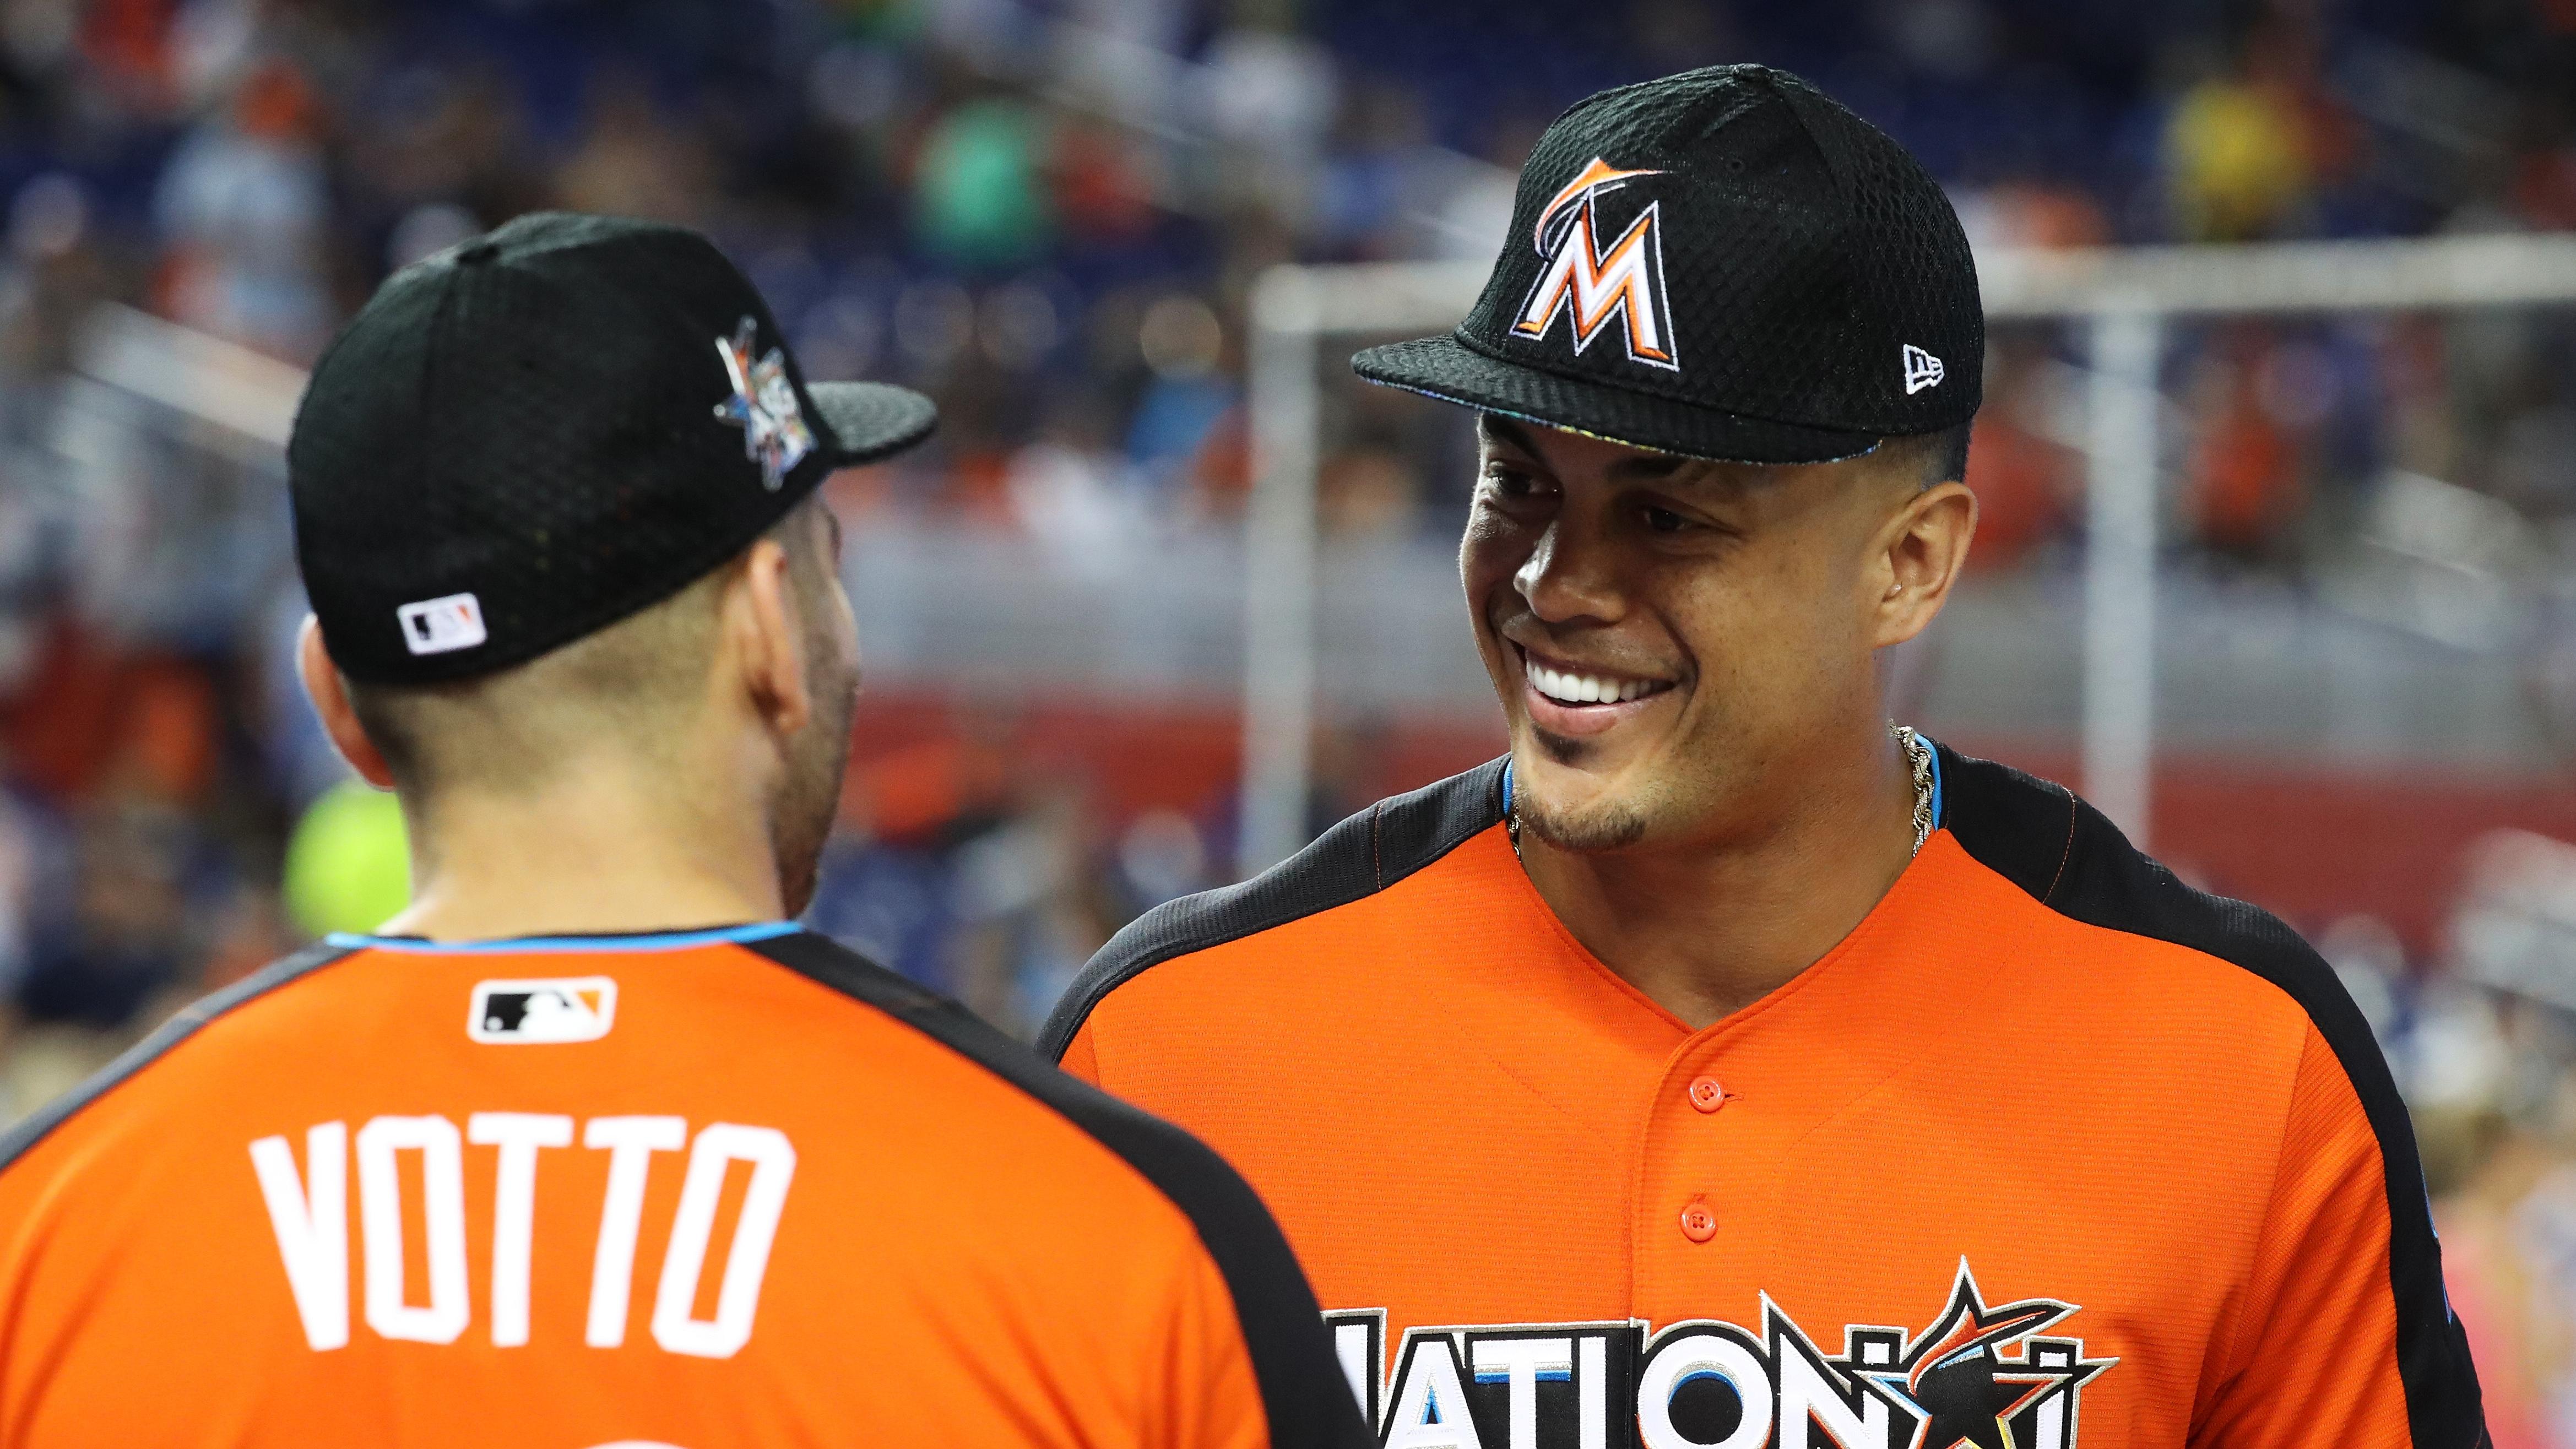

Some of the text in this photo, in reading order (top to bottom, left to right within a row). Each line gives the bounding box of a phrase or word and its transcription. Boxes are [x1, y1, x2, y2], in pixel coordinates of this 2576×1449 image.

[1509, 184, 1680, 372] M
[248, 1111, 797, 1359] VOTTO
[1324, 1307, 2093, 1449] ATION
